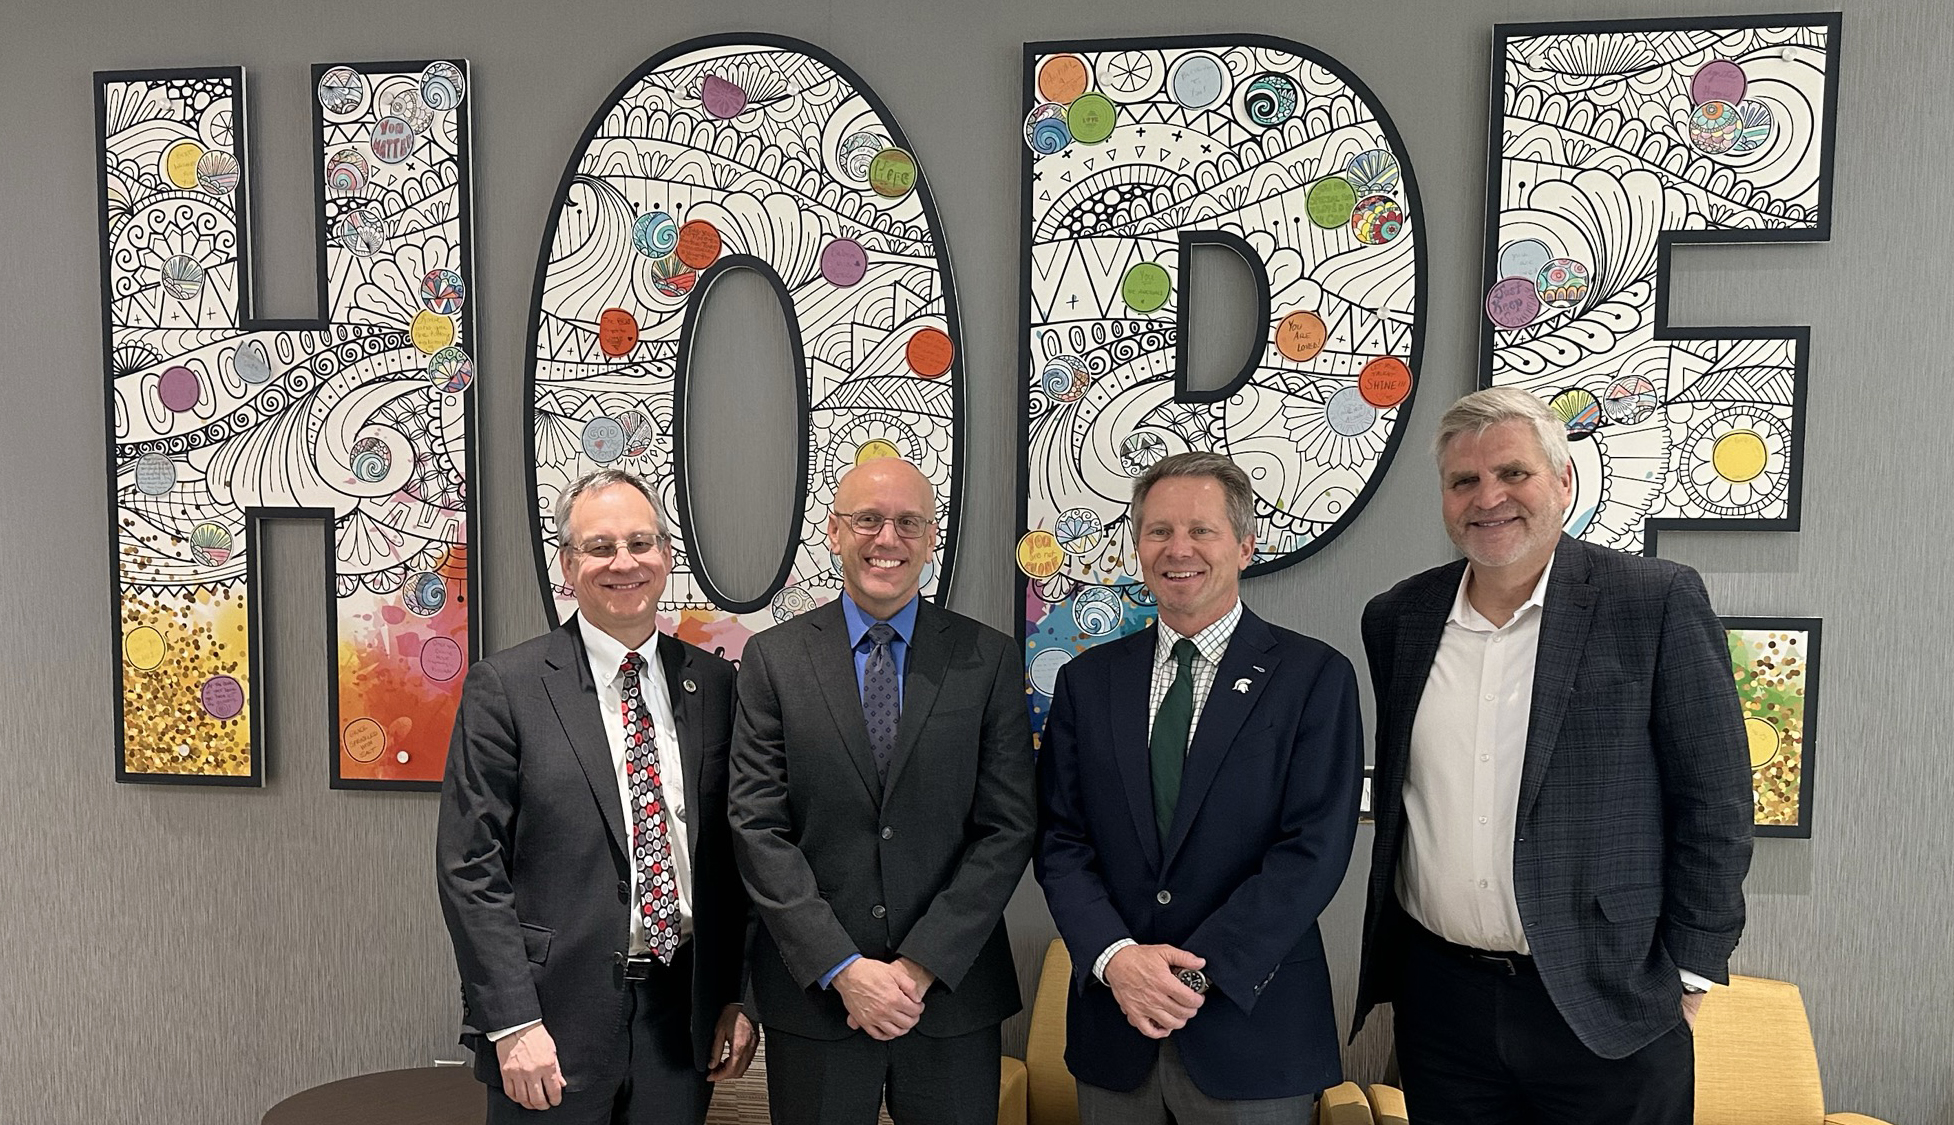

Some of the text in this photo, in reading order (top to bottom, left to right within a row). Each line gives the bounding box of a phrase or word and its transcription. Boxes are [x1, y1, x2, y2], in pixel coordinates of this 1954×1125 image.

[380, 120, 404, 135] YOU
[94, 12, 1842, 838] HOPE
[588, 426, 619, 440] GOD
[1025, 535, 1051, 557] YOU
